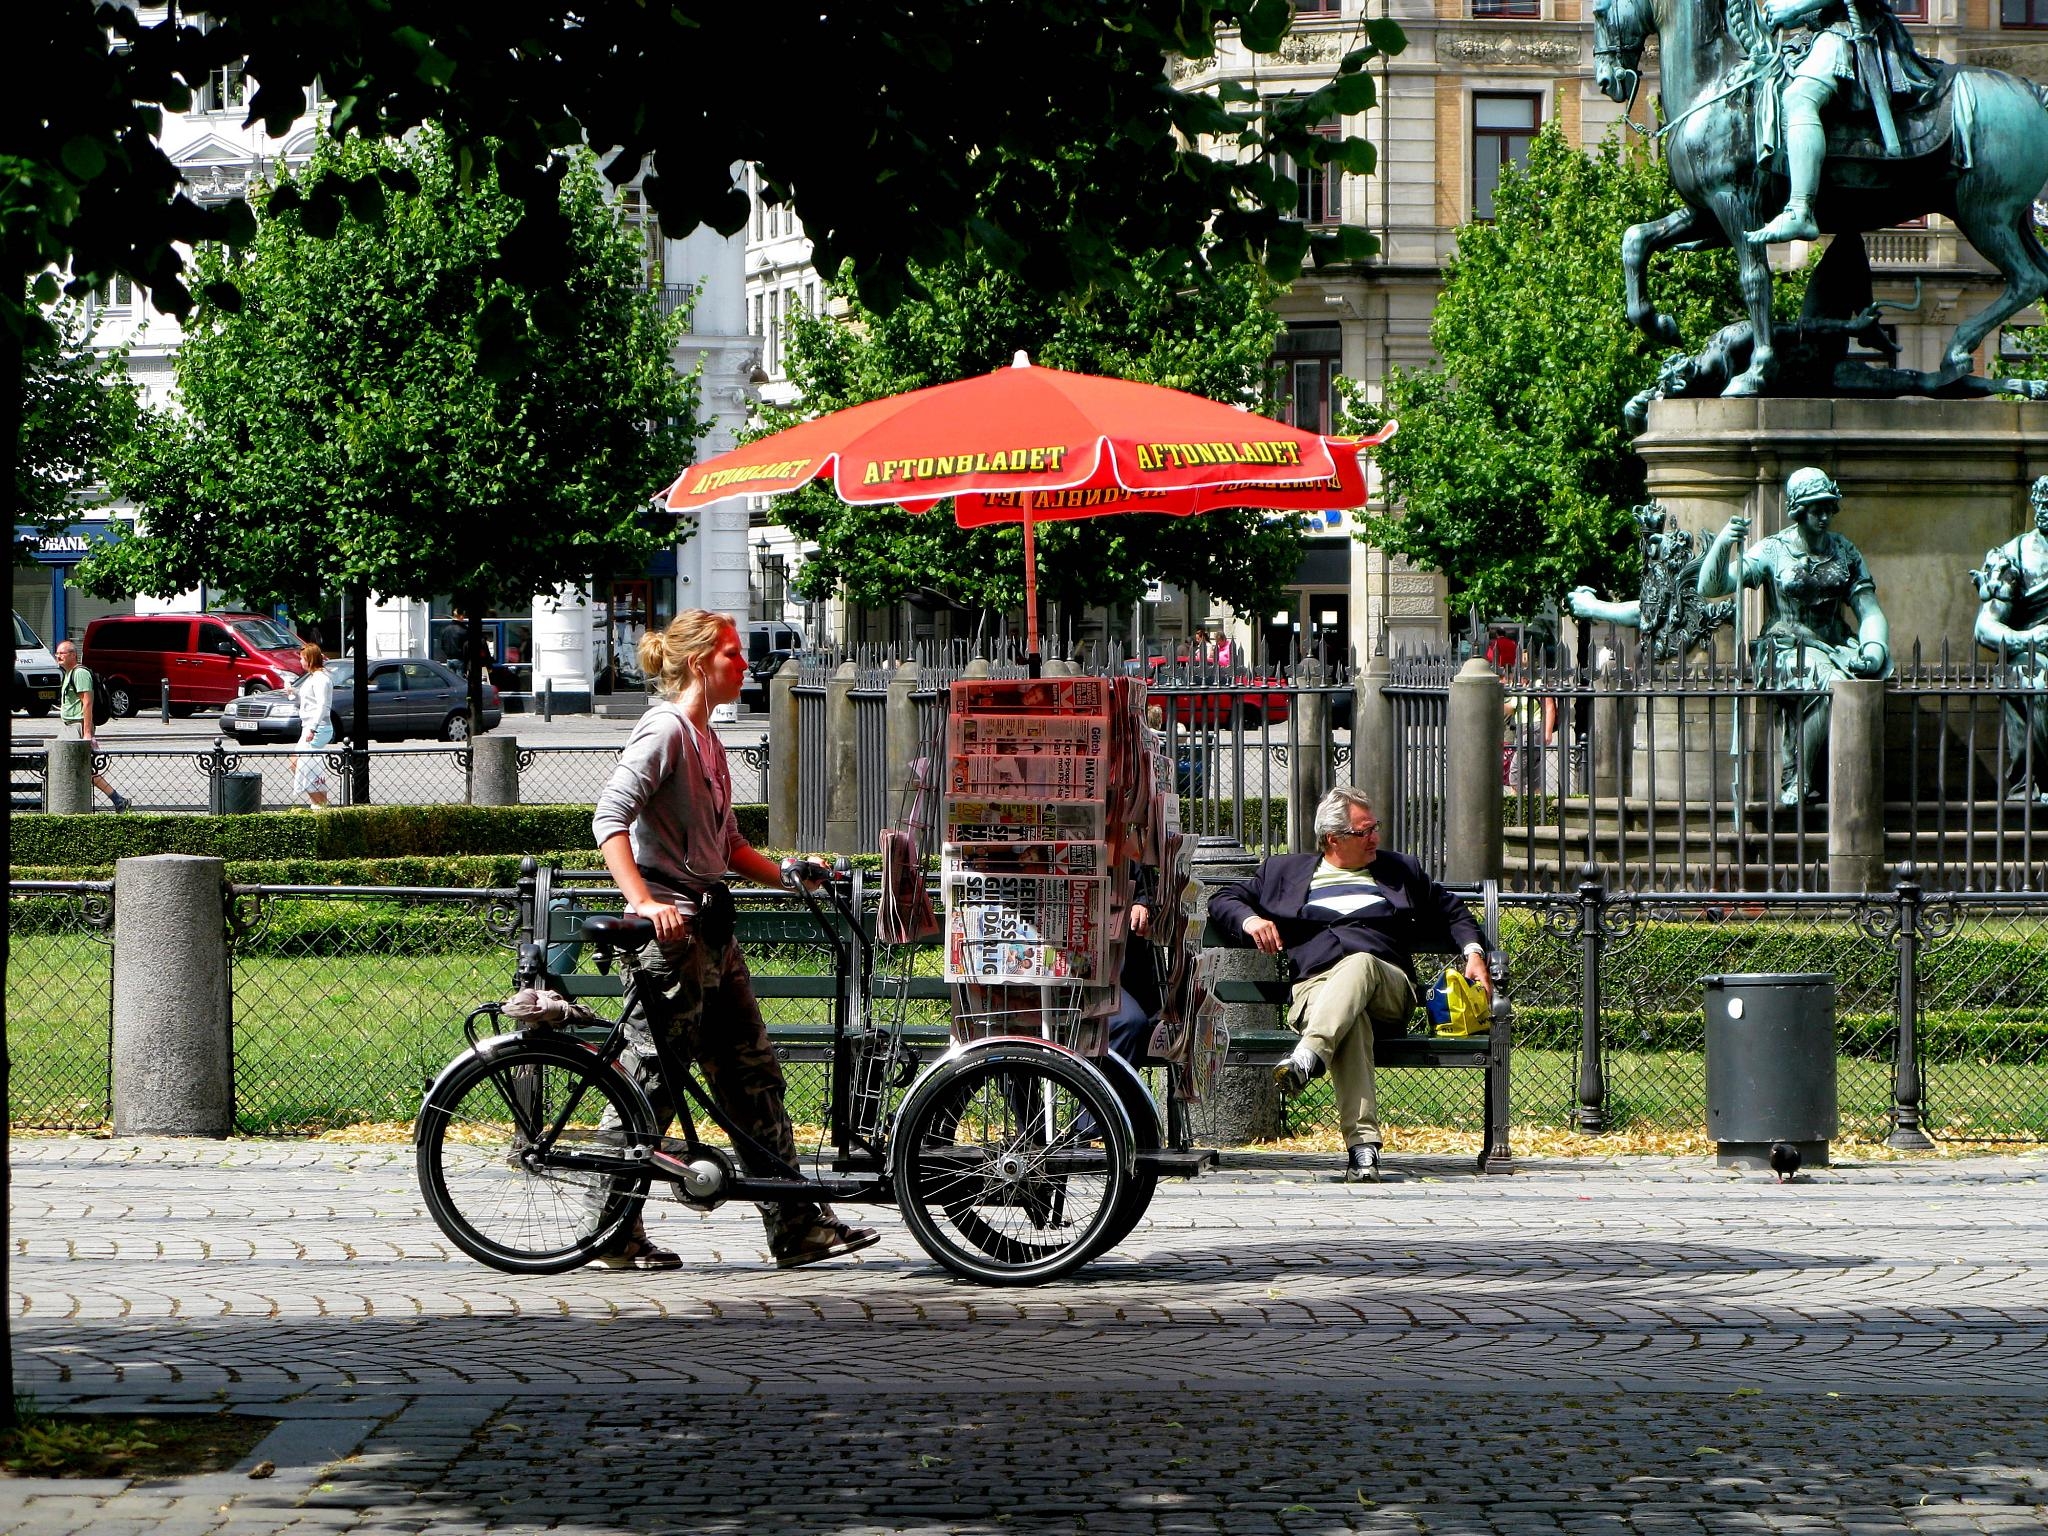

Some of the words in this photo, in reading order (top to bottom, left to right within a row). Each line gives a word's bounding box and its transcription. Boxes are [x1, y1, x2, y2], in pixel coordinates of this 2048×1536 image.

[863, 445, 1067, 484] AFTONBLADET
[1135, 440, 1302, 470] AFTONBLADET
[688, 459, 812, 495] AFTONBLADET
[967, 876, 982, 908] SEX
[1001, 877, 1016, 940] STRESS
[982, 911, 1001, 976] DÅRLIG
